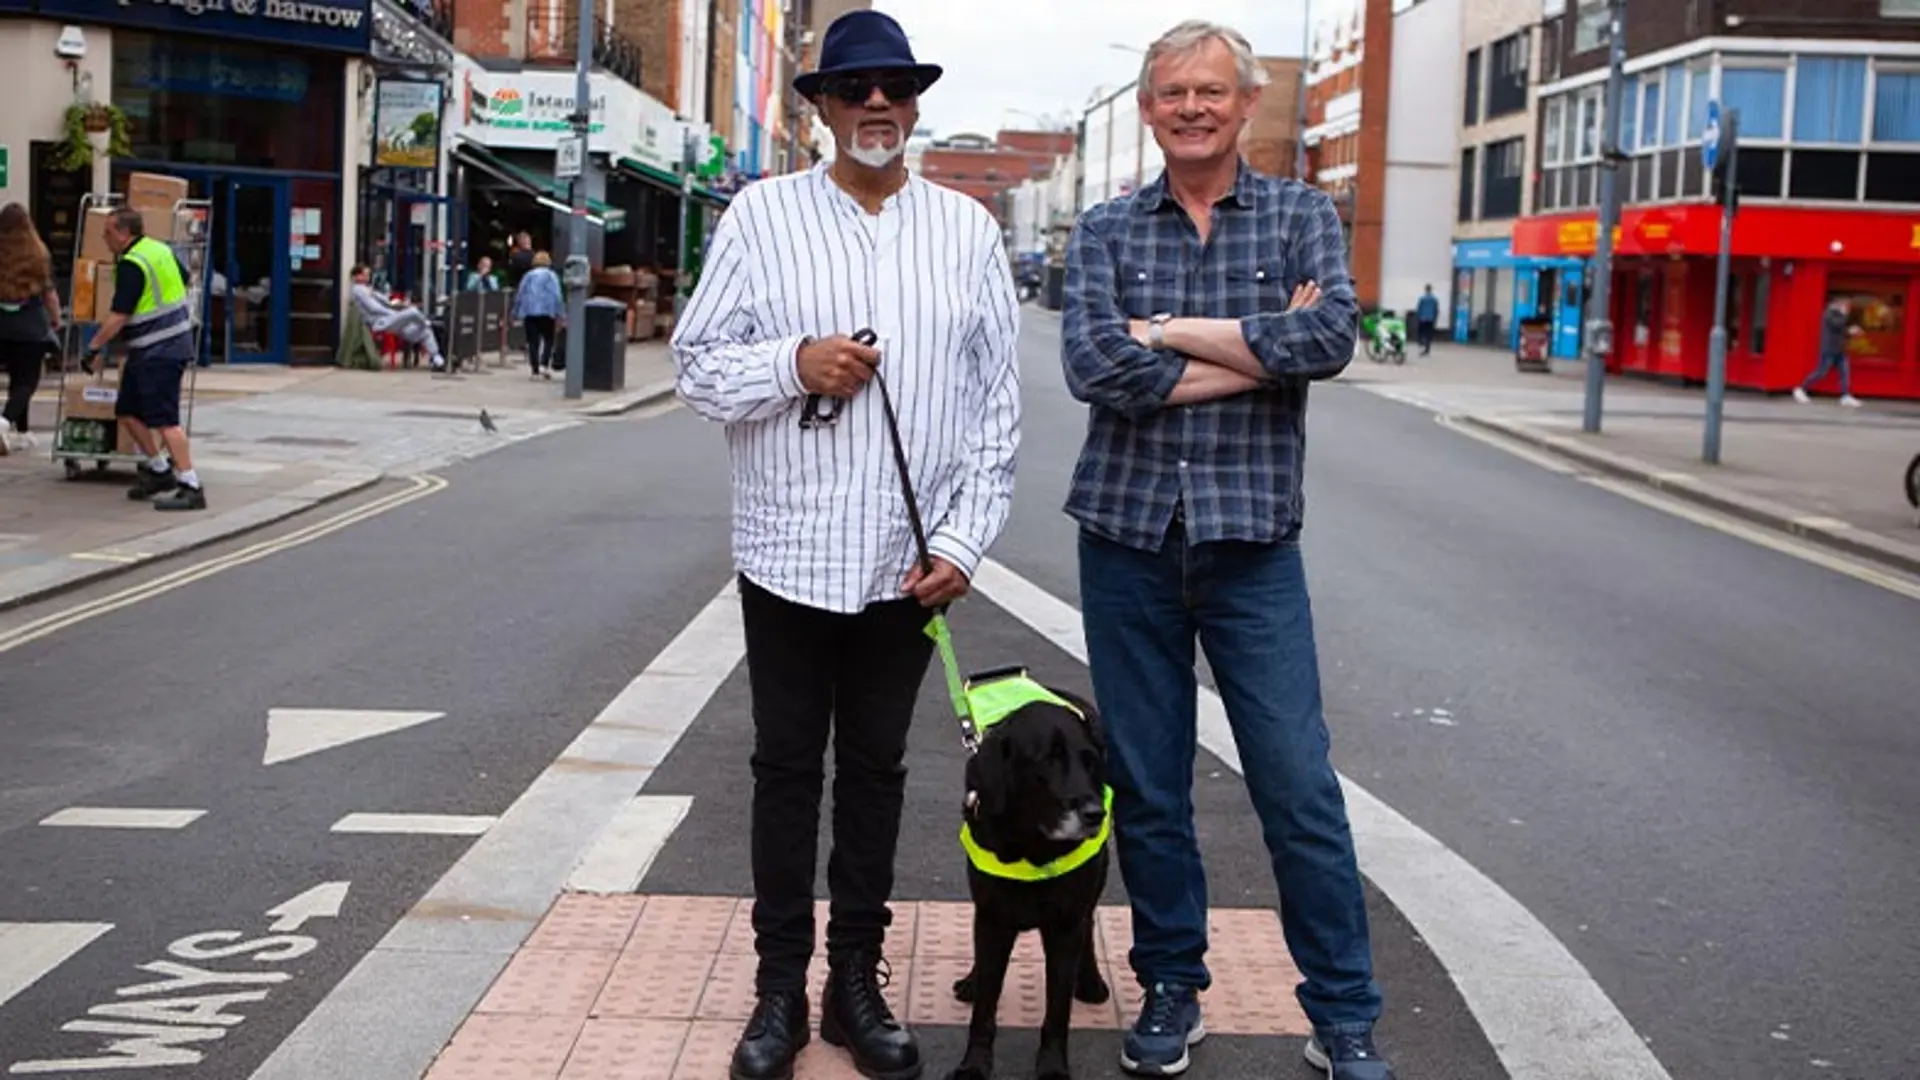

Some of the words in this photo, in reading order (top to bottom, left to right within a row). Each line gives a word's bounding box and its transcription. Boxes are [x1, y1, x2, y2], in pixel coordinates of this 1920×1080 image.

[264, 0, 363, 28] harrow
[529, 91, 605, 110] Istanul
[9, 930, 318, 1073] WAYS
